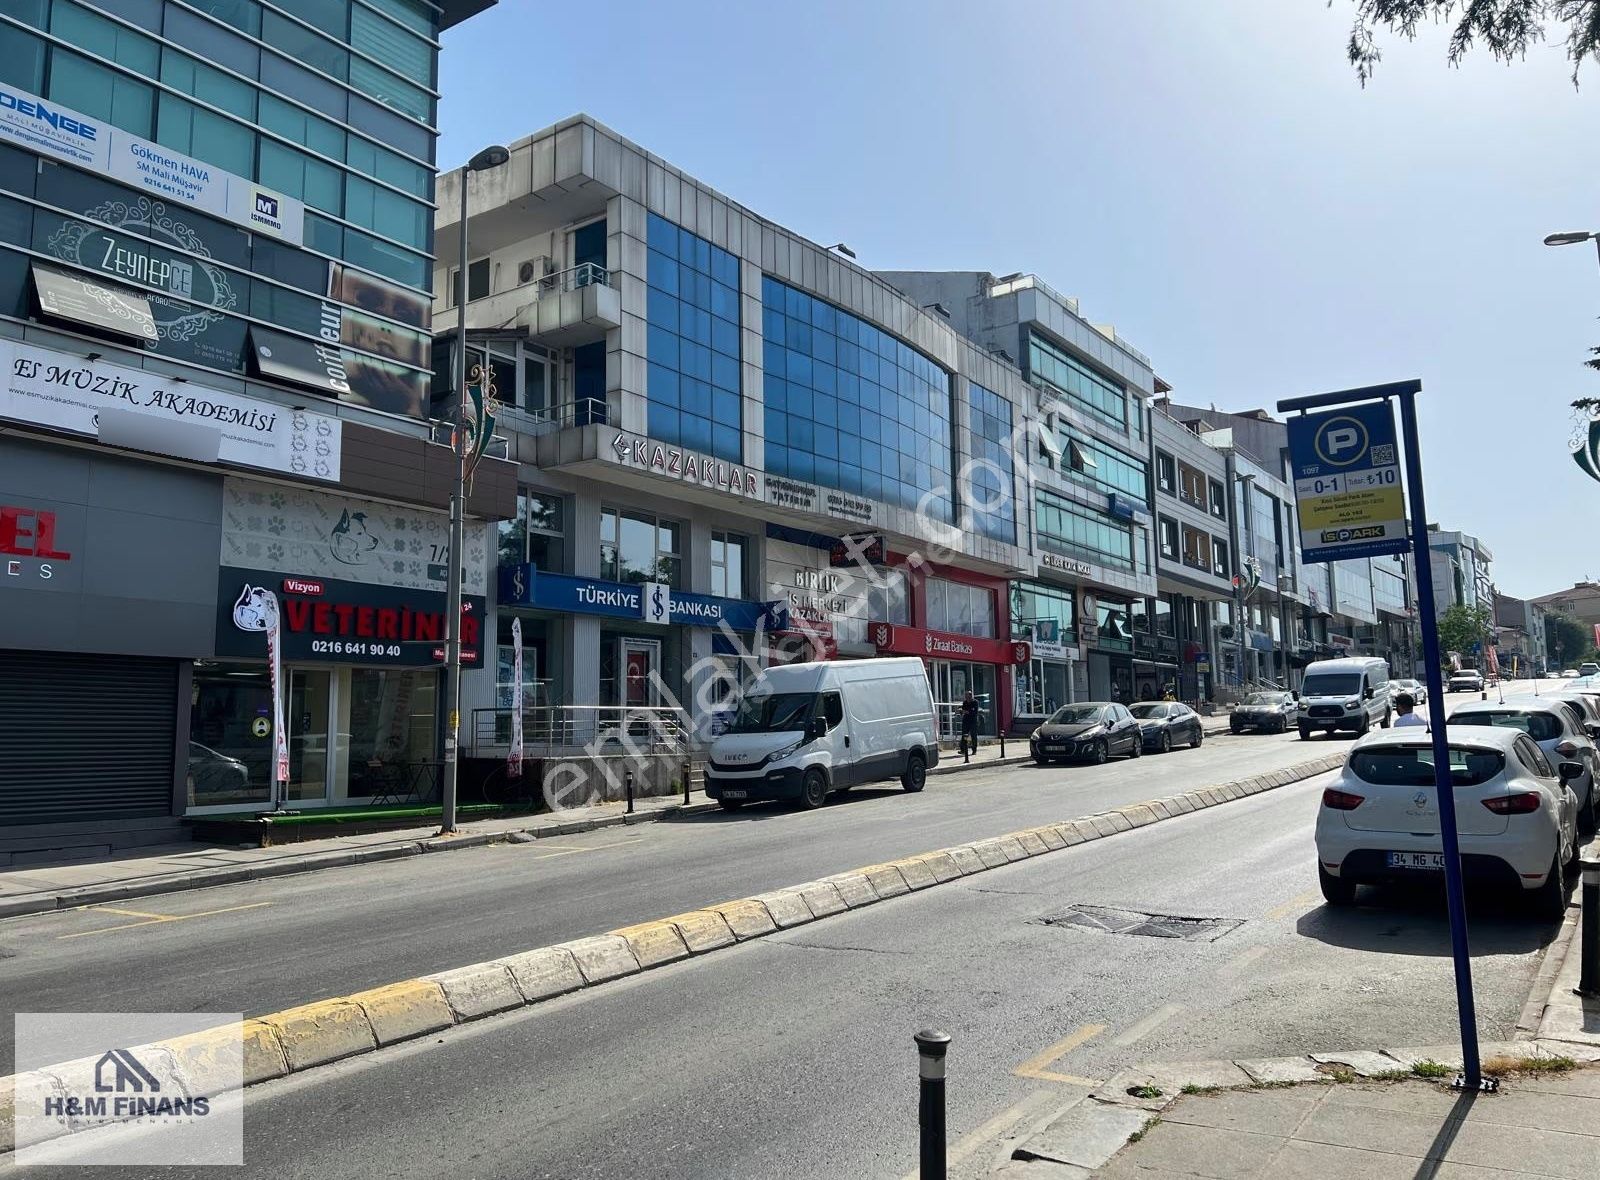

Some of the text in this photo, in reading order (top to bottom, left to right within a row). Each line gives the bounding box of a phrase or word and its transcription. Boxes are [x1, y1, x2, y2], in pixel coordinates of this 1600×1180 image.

[0, 91, 97, 142] DENGE
[130, 143, 210, 184] Gökmen HAVA
[136, 161, 203, 194] SM Mali Müşavir
[143, 176, 195, 201] 0216 641 51 54
[14, 358, 277, 433] ES MÜZİK AKADEMİSİ
[1327, 427, 1358, 455] P
[633, 440, 758, 495] KAZAKLAR
[1302, 466, 1319, 475] 1097
[1314, 477, 1338, 494] 0-1
[287, 580, 321, 594] Vizyon
[575, 584, 639, 609] TÜRKİYE
[669, 600, 722, 619] BANKASI
[286, 599, 480, 645] VETERİNR
[312, 640, 401, 657] 0216 641 90 40
[932, 637, 973, 655] Ziraat Bankası
[724, 753, 748, 761] IVECO
[1393, 853, 1406, 866] 34
